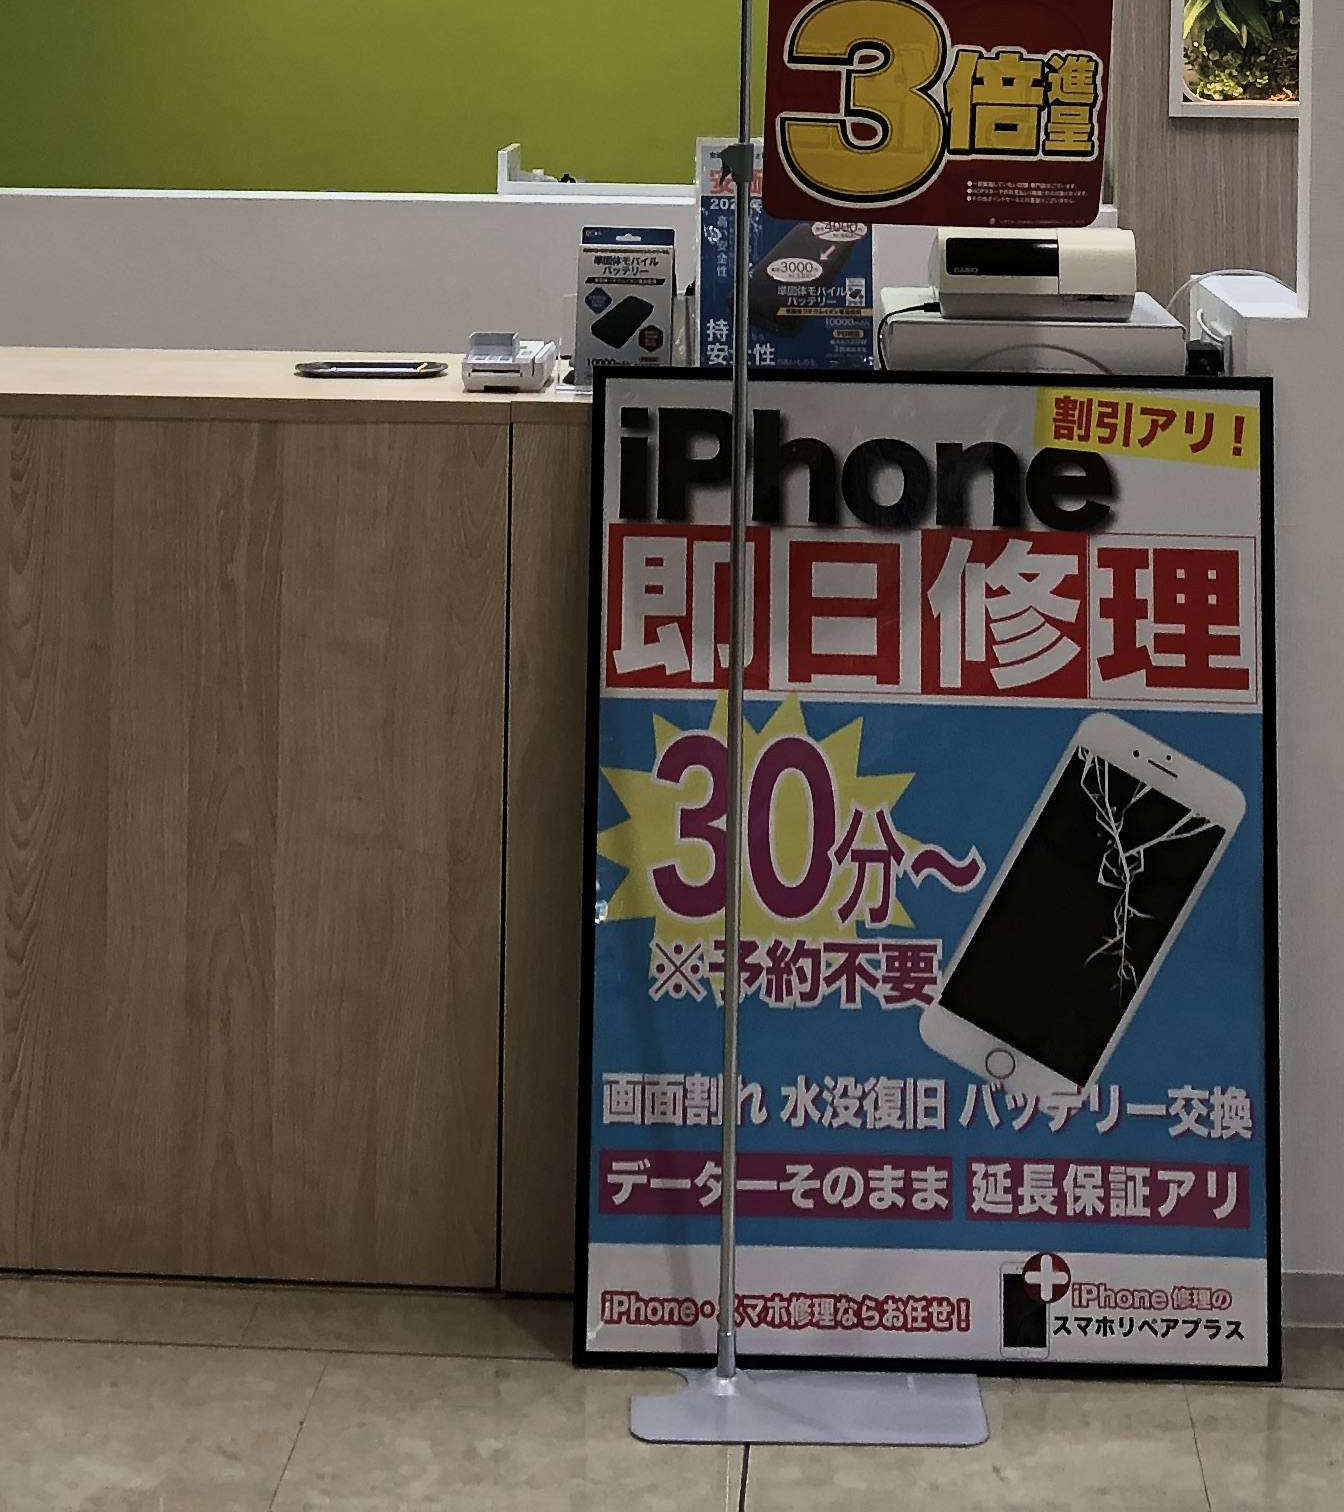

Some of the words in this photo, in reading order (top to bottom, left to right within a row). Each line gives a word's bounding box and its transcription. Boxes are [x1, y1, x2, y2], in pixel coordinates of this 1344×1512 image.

[707, 342, 776, 366] 安性
[619, 407, 1115, 531] iPhone
[613, 536, 1250, 690] 即日修理
[602, 1073, 767, 1126] 画面割れ
[780, 1076, 948, 1132] 水没復旧
[959, 1081, 1254, 1142] バッテリー交換
[607, 1158, 951, 1211] データーそのまま
[971, 1161, 1240, 1220] 延長保証アリ
[1072, 1282, 1169, 1311] iPhone
[1171, 1285, 1233, 1311] 修理の
[1053, 1316, 1245, 1341] スマホリペアプラス
